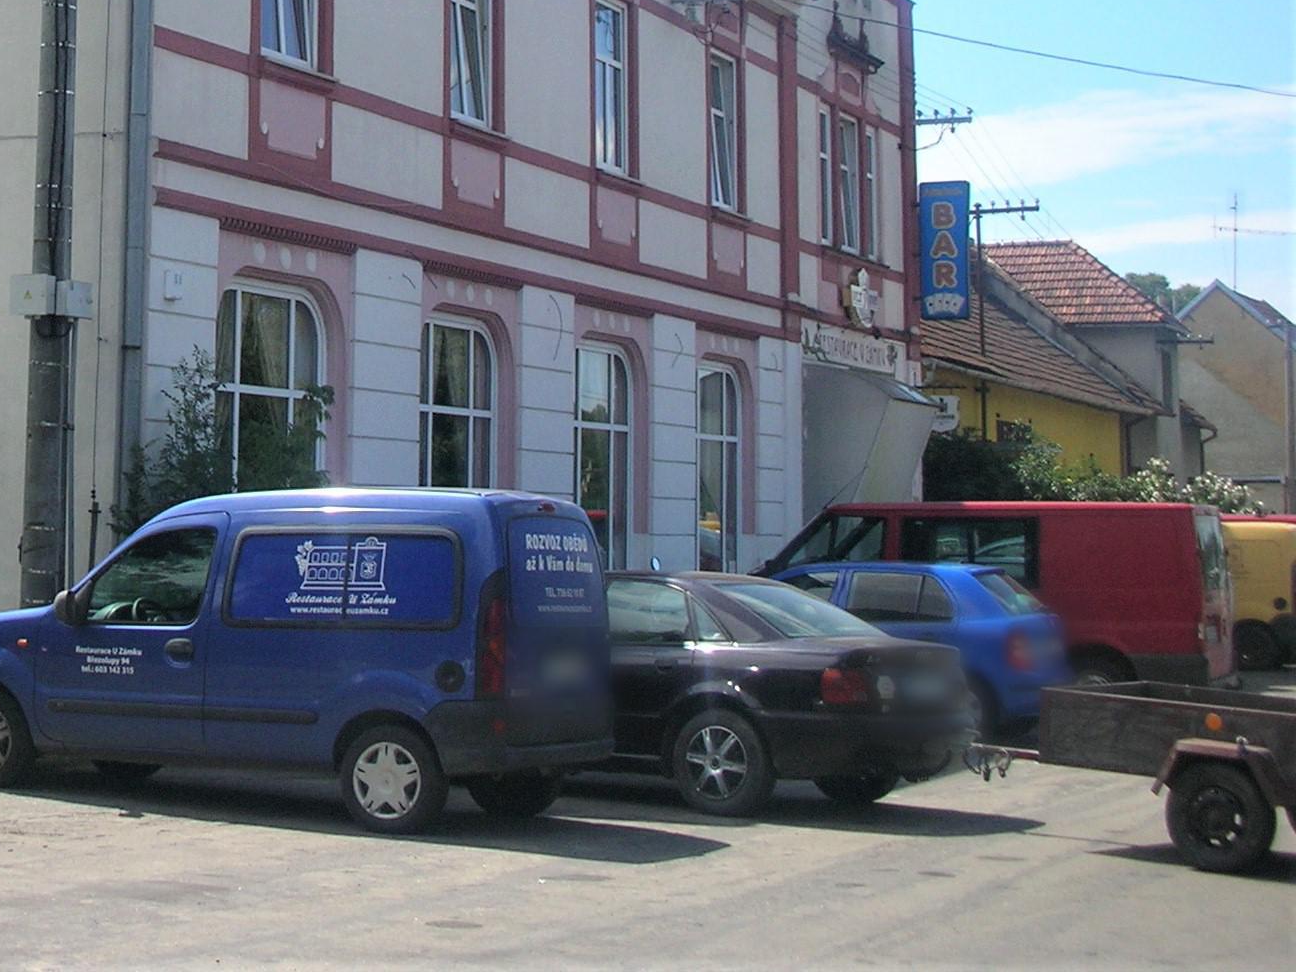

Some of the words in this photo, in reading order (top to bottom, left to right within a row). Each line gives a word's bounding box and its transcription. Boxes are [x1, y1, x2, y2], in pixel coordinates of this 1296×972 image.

[930, 201, 958, 288] BAR
[525, 533, 561, 550] ROZVOZ
[526, 555, 537, 571] až
[538, 554, 544, 571] k
[545, 554, 564, 571] Vám
[565, 555, 574, 572] do
[285, 591, 343, 604] Restaurace
[348, 593, 358, 605] U
[359, 592, 397, 605] Zámku
